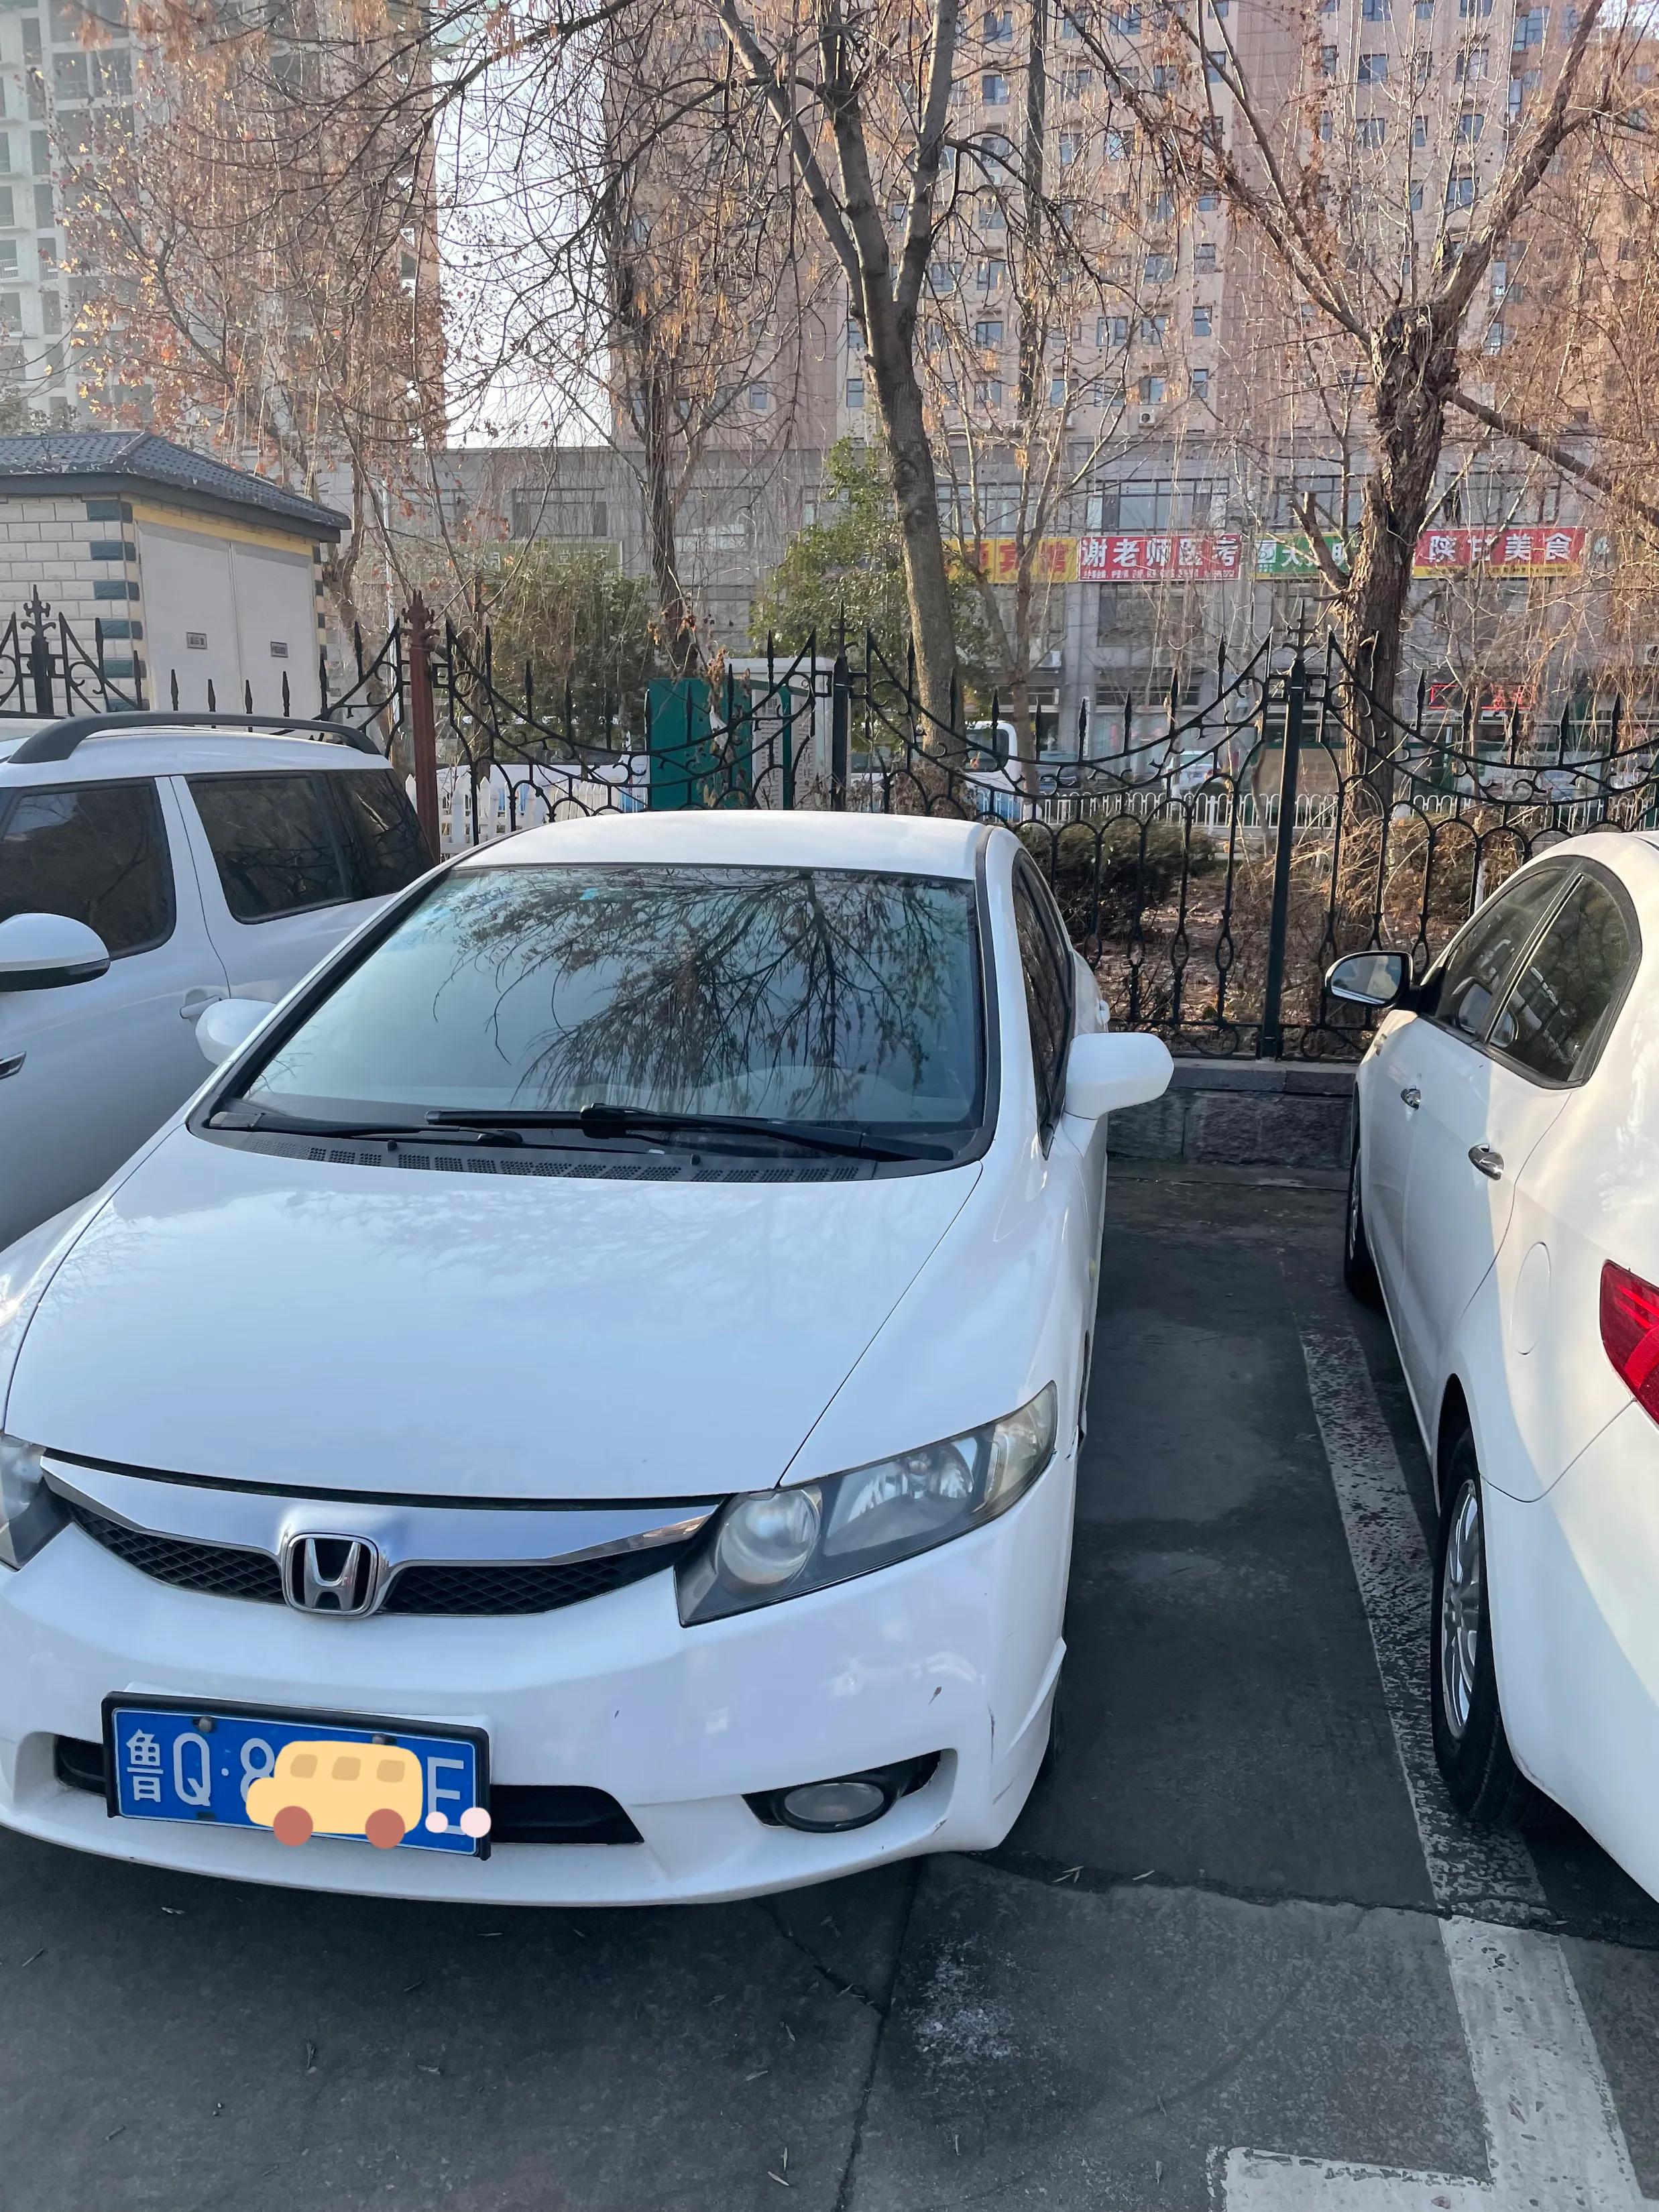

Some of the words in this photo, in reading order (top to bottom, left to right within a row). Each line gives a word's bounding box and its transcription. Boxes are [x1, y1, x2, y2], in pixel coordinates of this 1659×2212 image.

[1082, 537, 1239, 567] 谢老师医考
